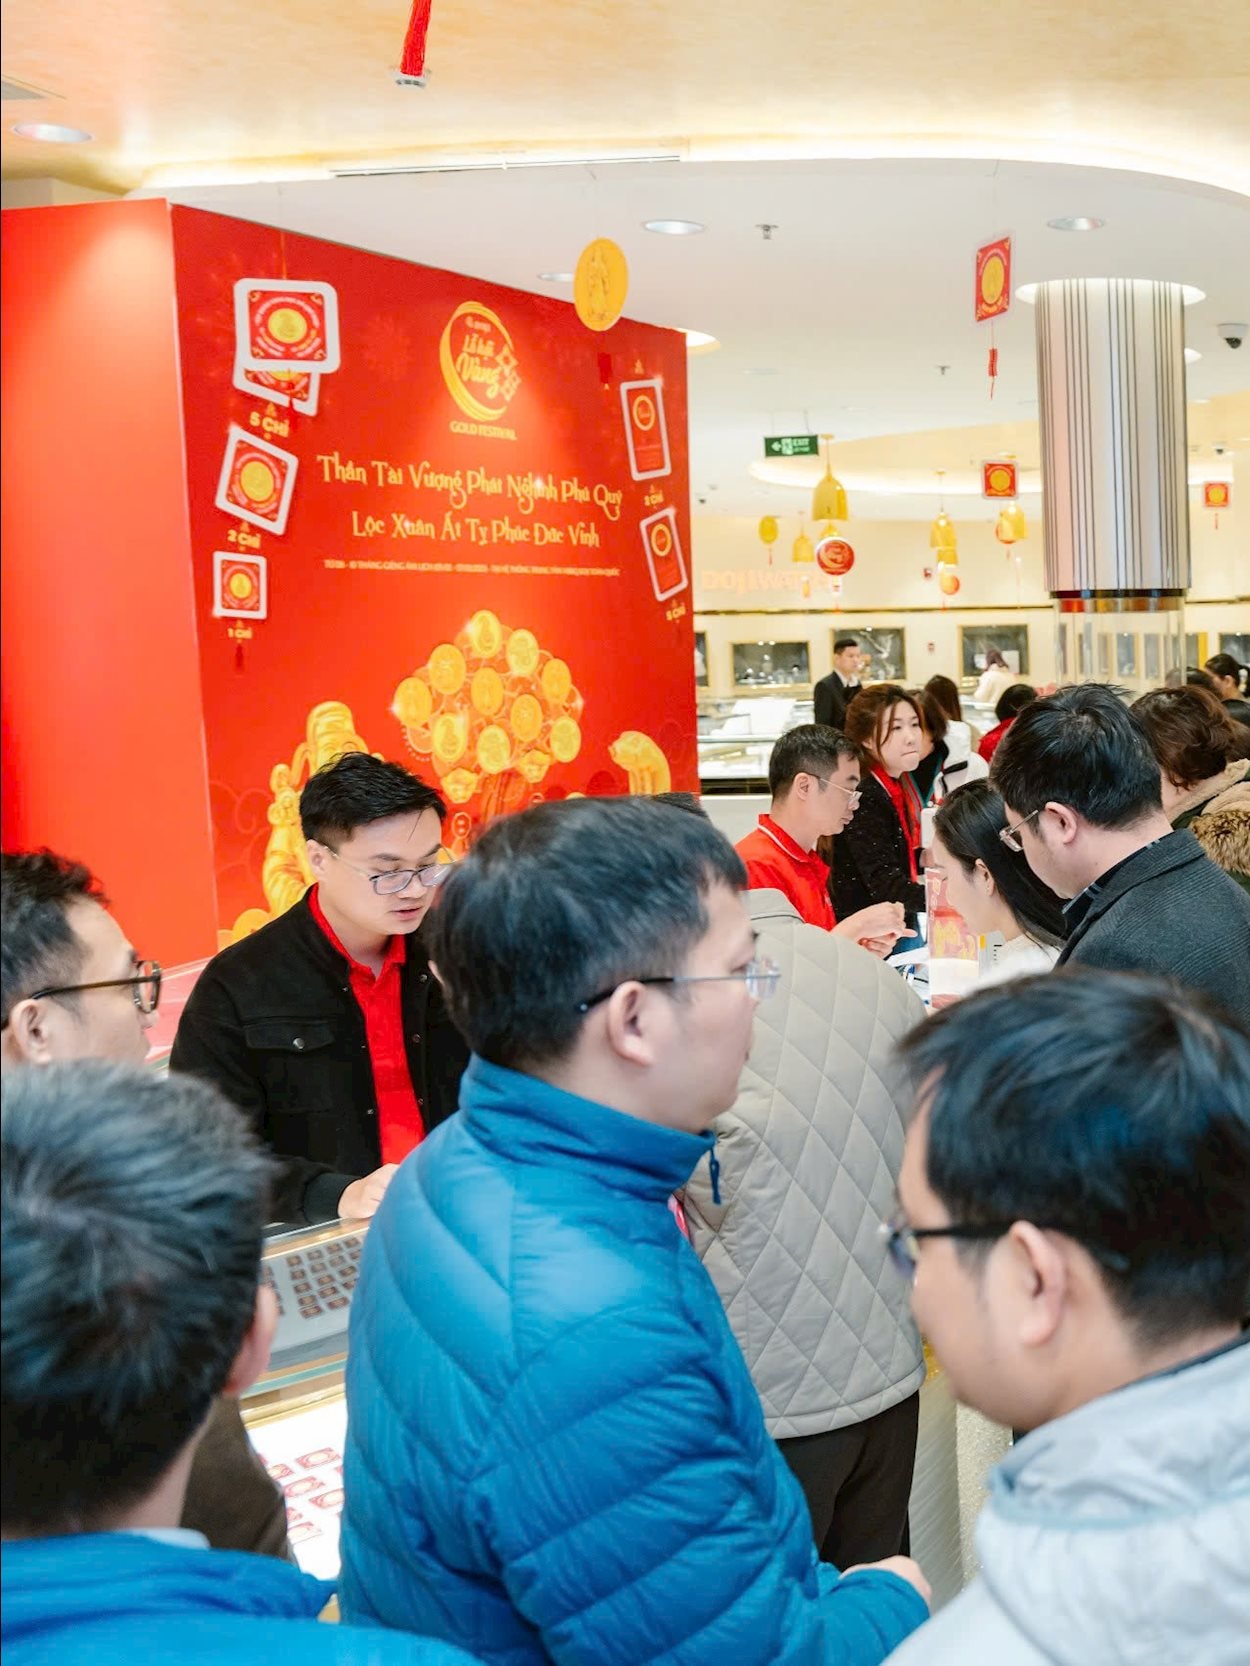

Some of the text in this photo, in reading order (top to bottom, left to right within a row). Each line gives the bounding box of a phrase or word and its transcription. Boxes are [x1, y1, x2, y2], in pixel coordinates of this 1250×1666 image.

[250, 411, 260, 427] 5
[449, 420, 518, 441] GOLD FESTIVAL
